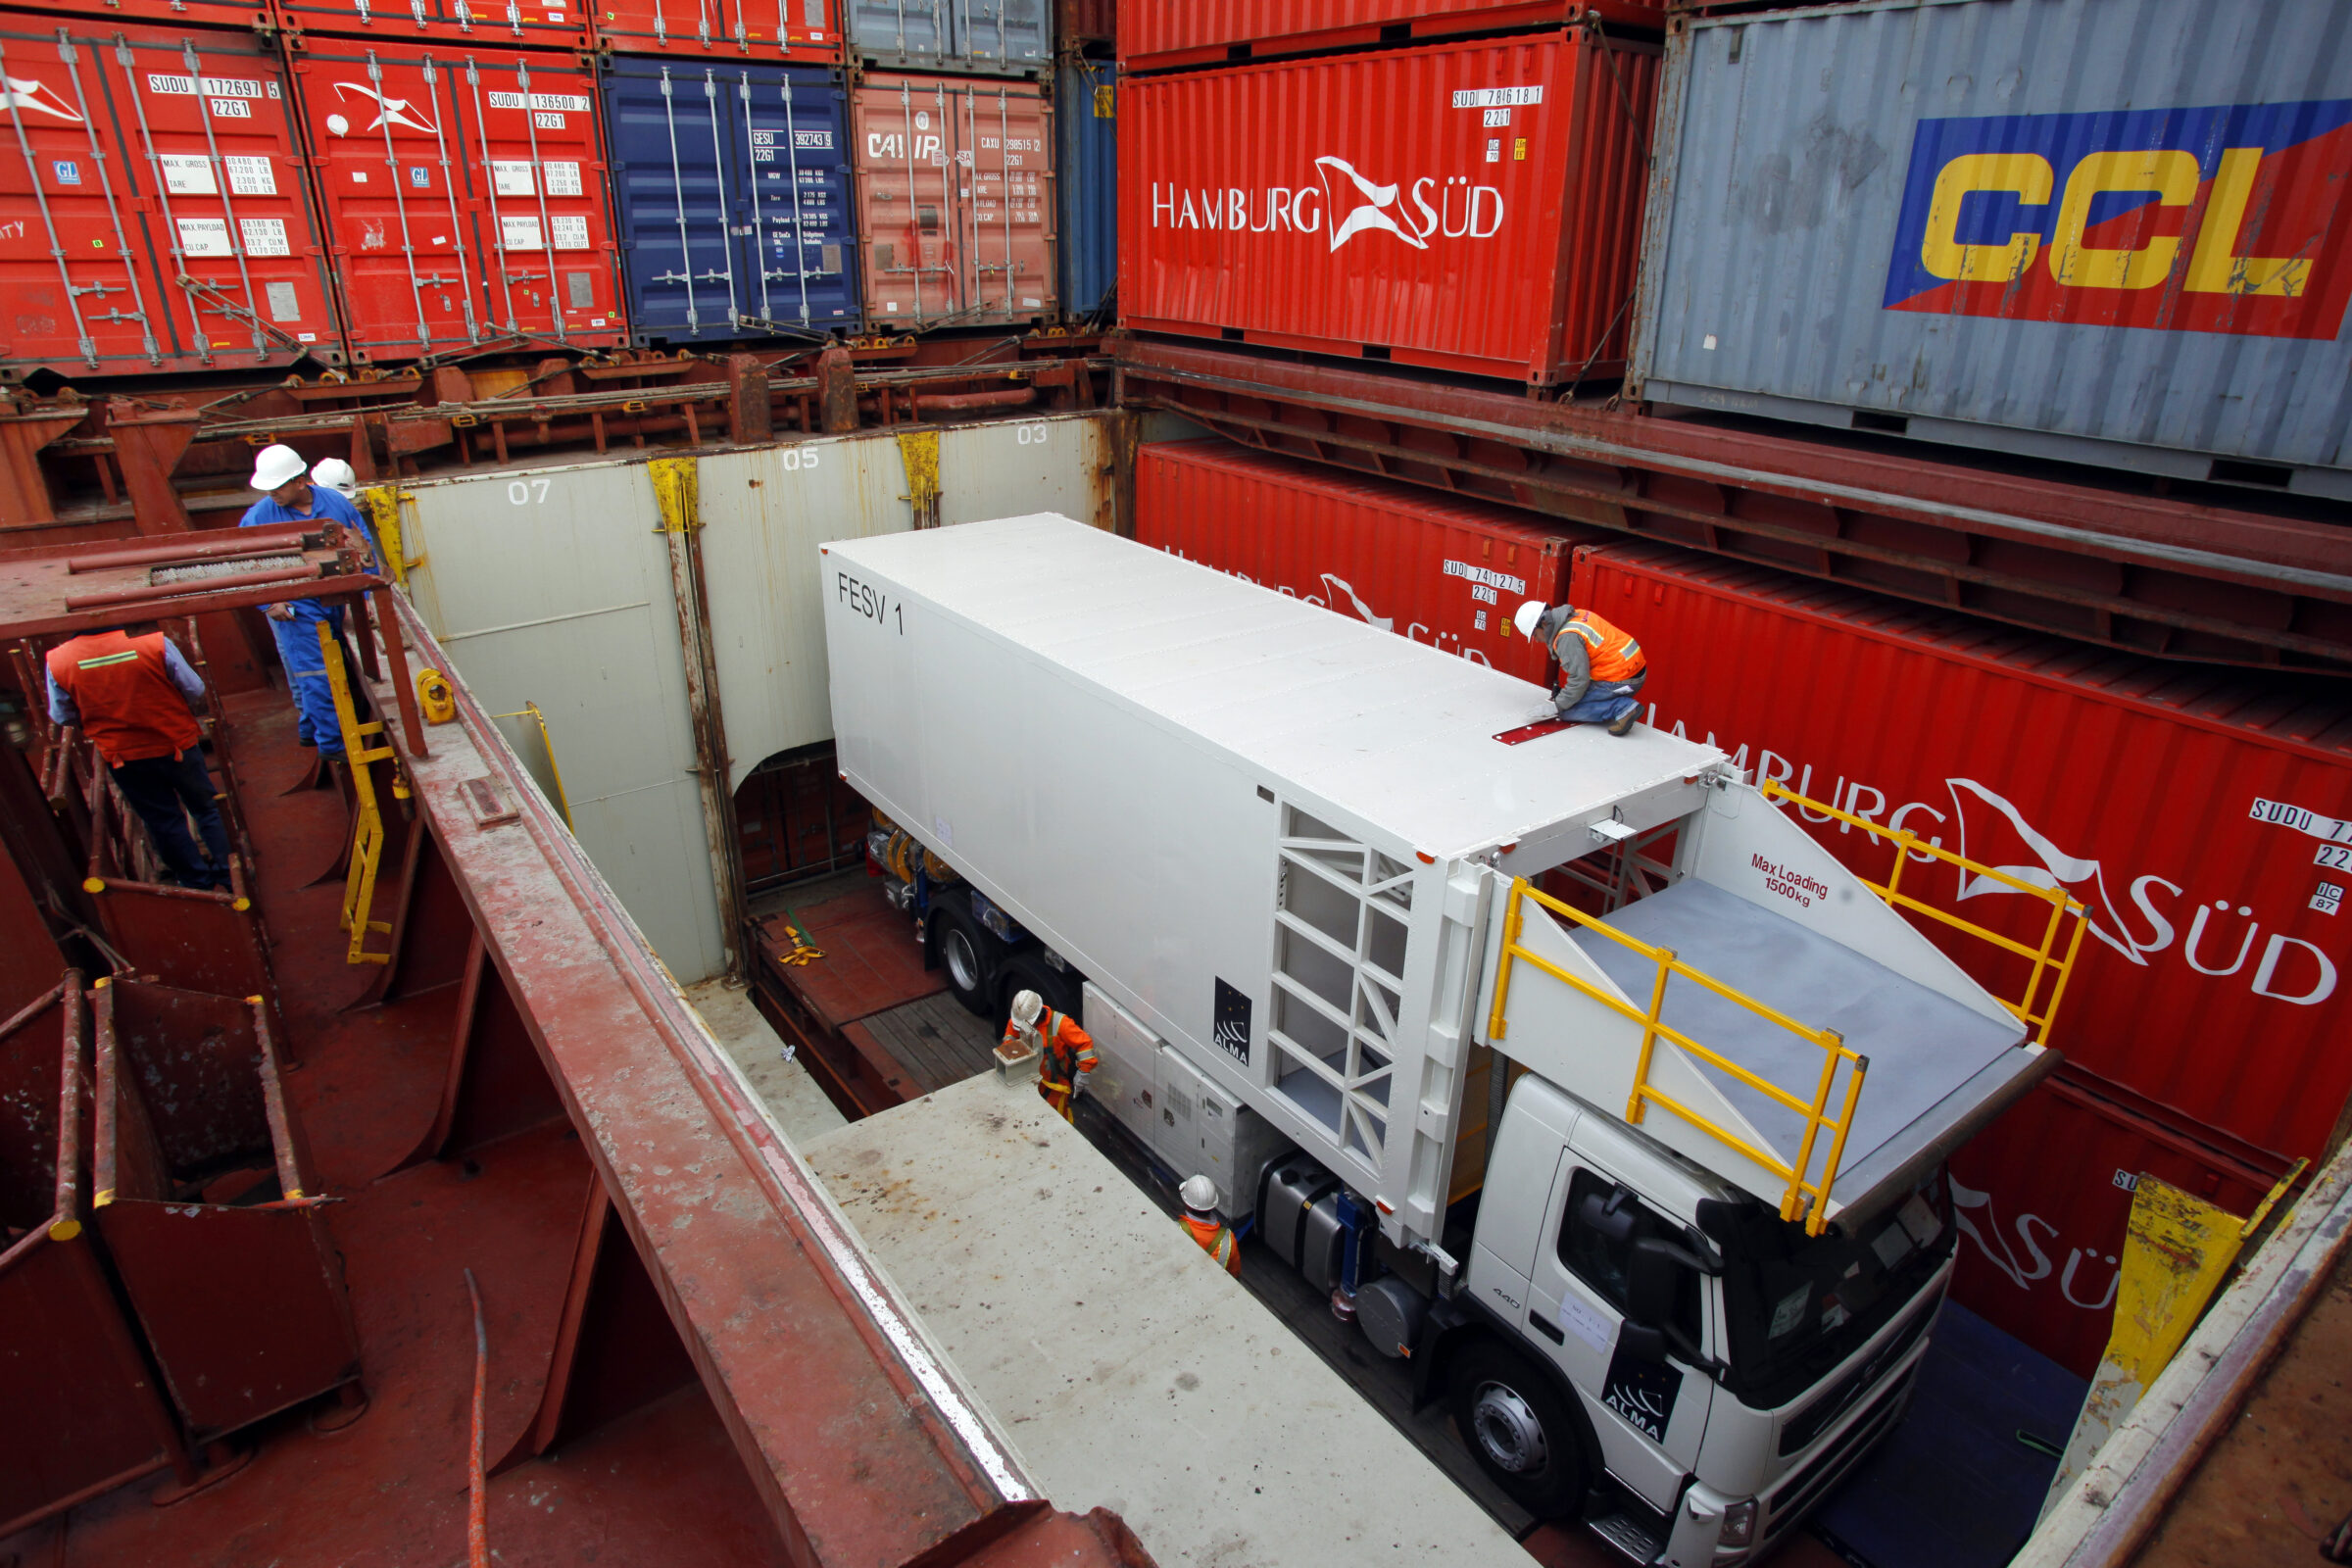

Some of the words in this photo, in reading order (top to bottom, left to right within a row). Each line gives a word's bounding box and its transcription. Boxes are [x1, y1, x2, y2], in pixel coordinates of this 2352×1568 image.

[151, 76, 188, 92] SUDU
[209, 79, 259, 96] 172697
[269, 82, 277, 97] 5
[214, 100, 249, 117] 22G1
[490, 92, 519, 107] SUDU
[535, 95, 575, 110] 136500
[582, 97, 588, 110] 2
[536, 114, 564, 127] 22G1
[753, 132, 774, 145] GESU
[795, 133, 823, 146] 392743
[981, 137, 1000, 148] CAXU
[185, 160, 208, 169] GROSS
[755, 149, 774, 162] 22G1
[57, 163, 77, 177] GL
[169, 179, 187, 188] TARE
[1152, 182, 1320, 233] HAMBURG
[1412, 175, 1503, 238] SÜD
[1921, 147, 2314, 297] CCL
[1018, 424, 1047, 445] 03
[783, 447, 819, 470] 05
[508, 478, 551, 505] 07
[1517, 580, 1523, 594] 5
[839, 571, 885, 624] FESV
[895, 603, 903, 635] 1
[2252, 800, 2313, 831] SUDU
[2330, 820, 2352, 843] 7
[2318, 846, 2352, 871] 22
[1751, 853, 1777, 875] Max
[1779, 864, 1828, 900] Loading
[2316, 899, 2334, 910] 87
[2130, 874, 2337, 1005] SÜD
[1215, 1033, 1248, 1065] ALMA
[1493, 1288, 1520, 1309] 440
[1605, 1395, 1659, 1441] ALMA
